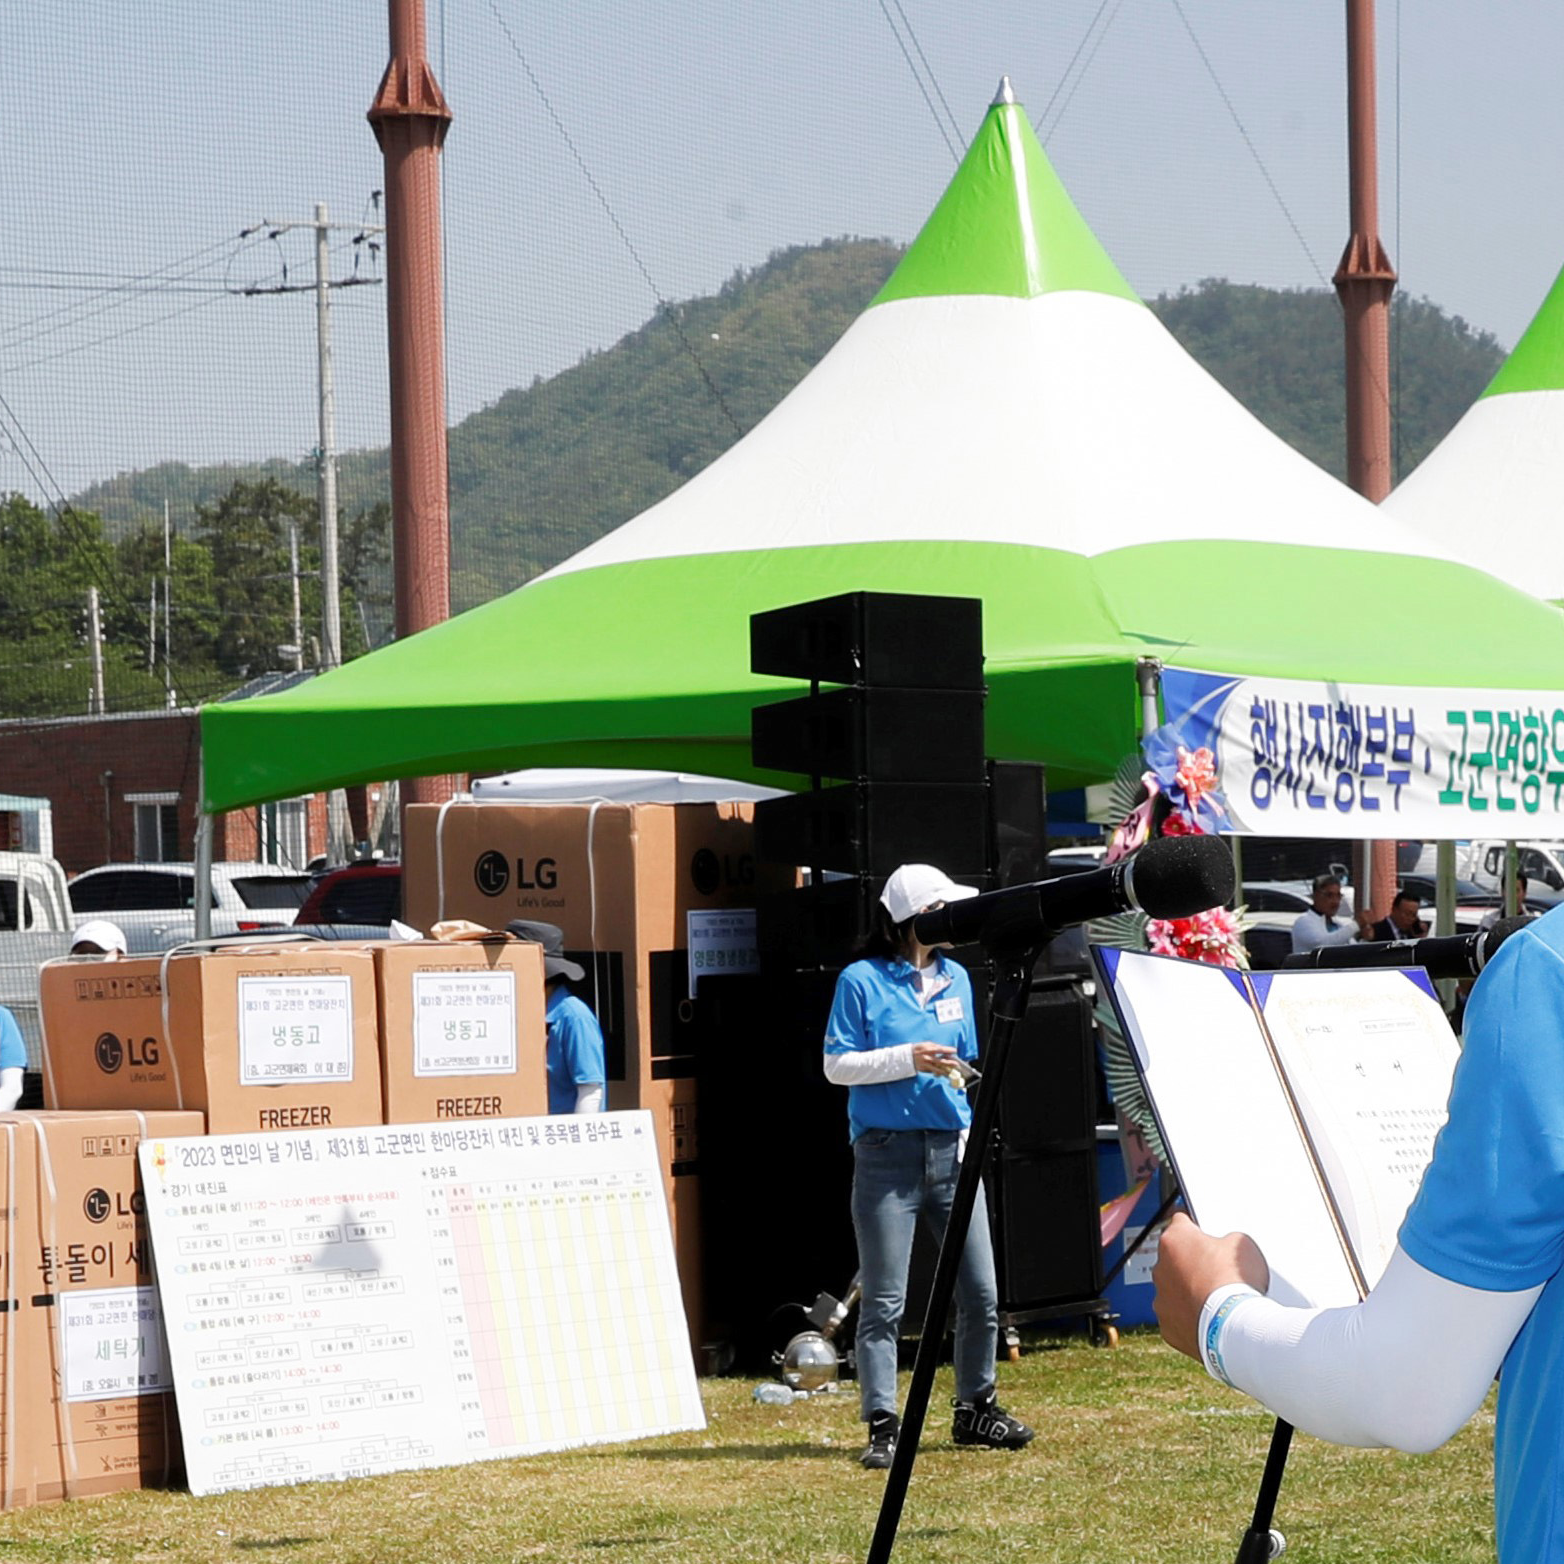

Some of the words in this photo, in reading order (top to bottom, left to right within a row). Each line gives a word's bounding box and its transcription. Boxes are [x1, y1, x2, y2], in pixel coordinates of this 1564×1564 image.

[1250, 696, 1415, 812] 행사진행본부
[517, 858, 558, 890] LG
[272, 1025, 320, 1047] 냉동고
[444, 1020, 487, 1041] 냉동고
[127, 1037, 159, 1066] LG
[259, 1106, 332, 1129] FREEZER
[436, 1096, 502, 1118] FREEZER
[220, 1143, 262, 1165] 면민의
[266, 1142, 280, 1163] 날
[328, 1137, 370, 1159] 제31회
[374, 1133, 426, 1155] 고군면민
[430, 1128, 494, 1152] 한마당잔치
[498, 1126, 523, 1147] 대진
[527, 1125, 540, 1145] 및
[543, 1124, 581, 1145] 종목별
[584, 1121, 623, 1142] 점수표
[196, 1182, 227, 1195] 대진표
[95, 1336, 145, 1360] 세탁기
